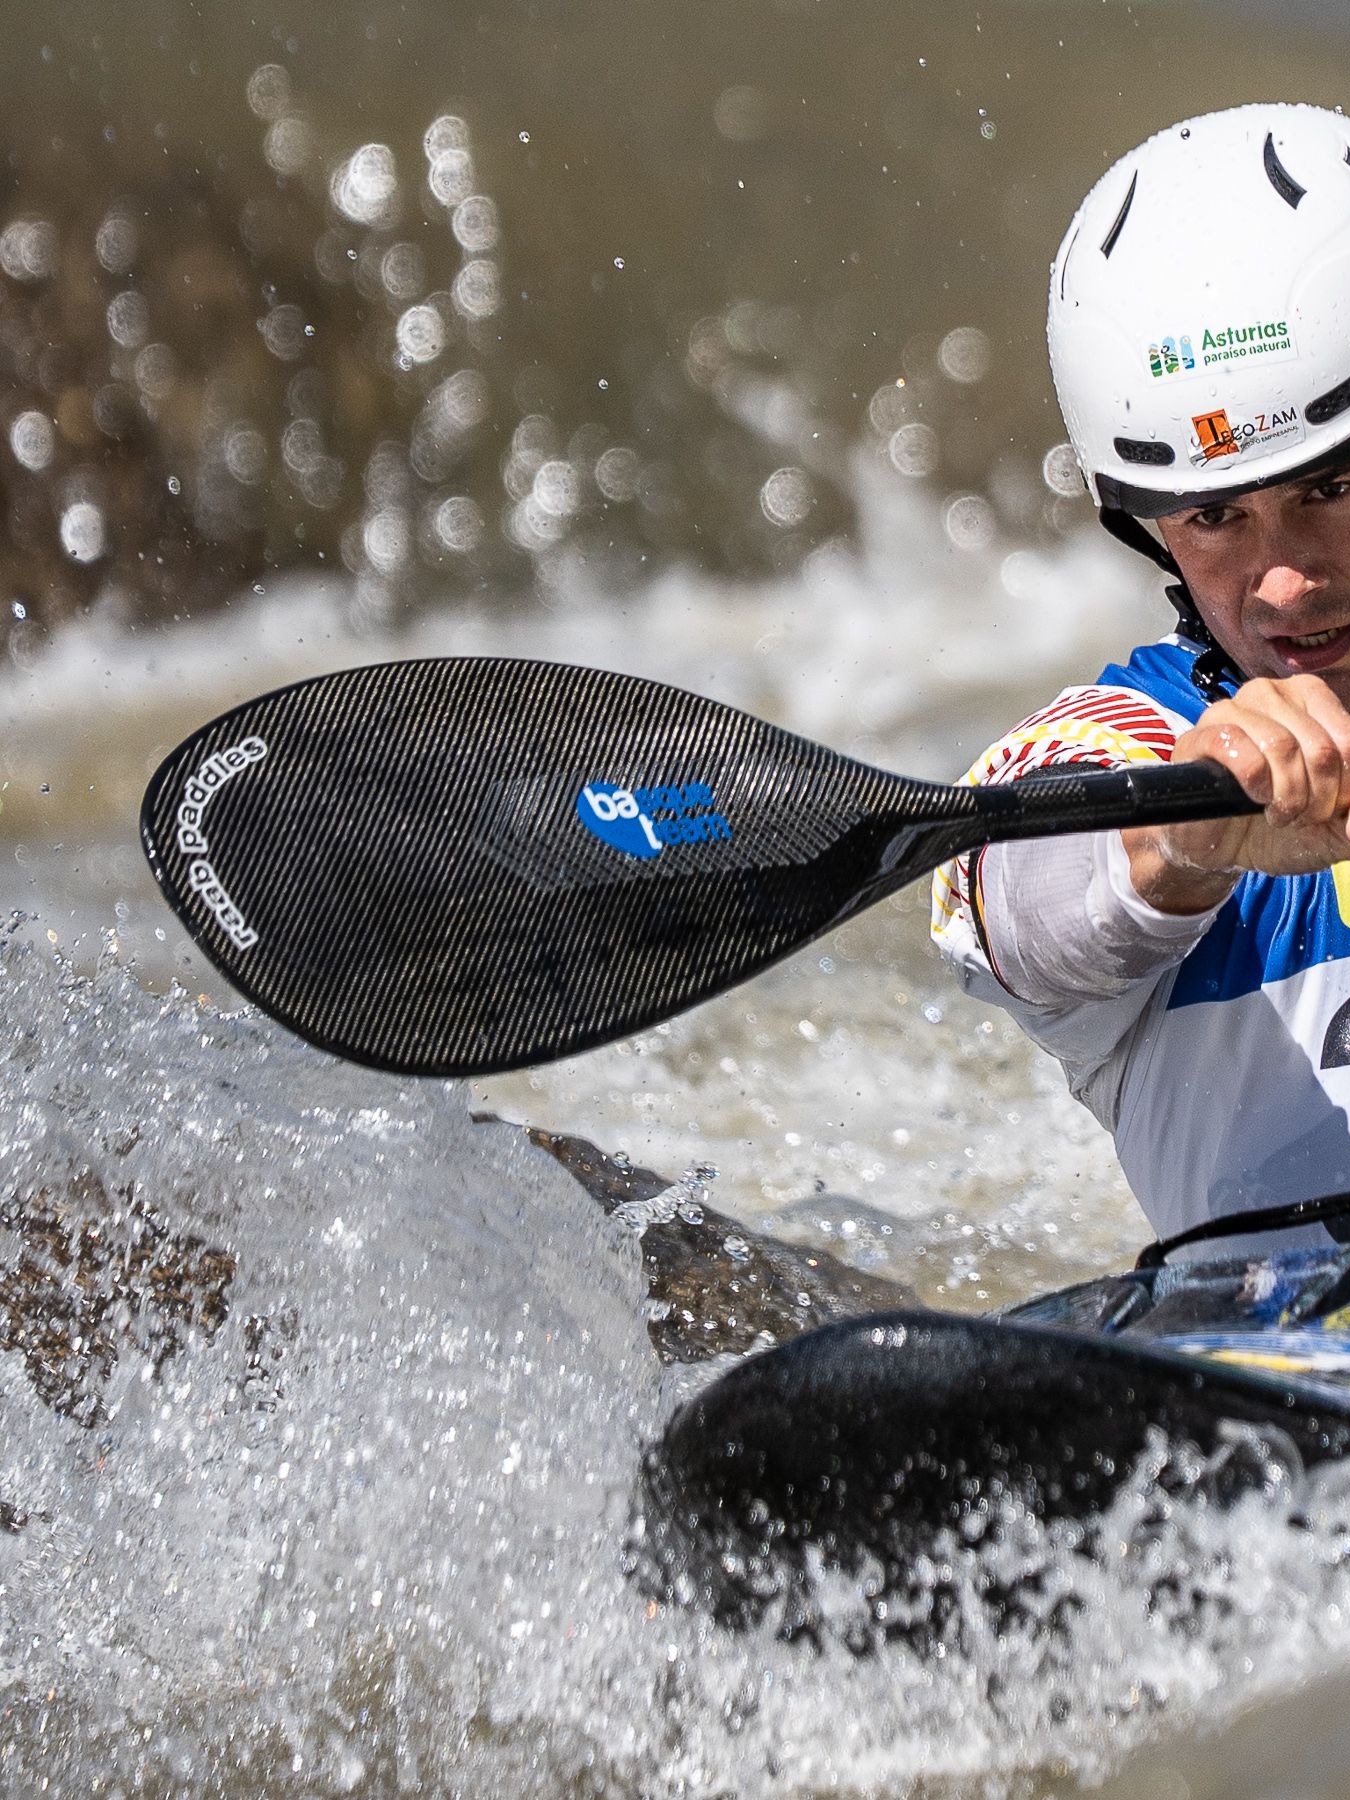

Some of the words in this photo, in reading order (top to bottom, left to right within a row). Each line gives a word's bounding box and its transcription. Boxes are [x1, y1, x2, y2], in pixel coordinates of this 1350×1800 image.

[1201, 320, 1288, 351] Asturias
[1203, 347, 1247, 366] paraíso
[1249, 338, 1291, 355] natural
[178, 736, 267, 853] paddles
[638, 811, 732, 850] team
[190, 860, 258, 950] raab
